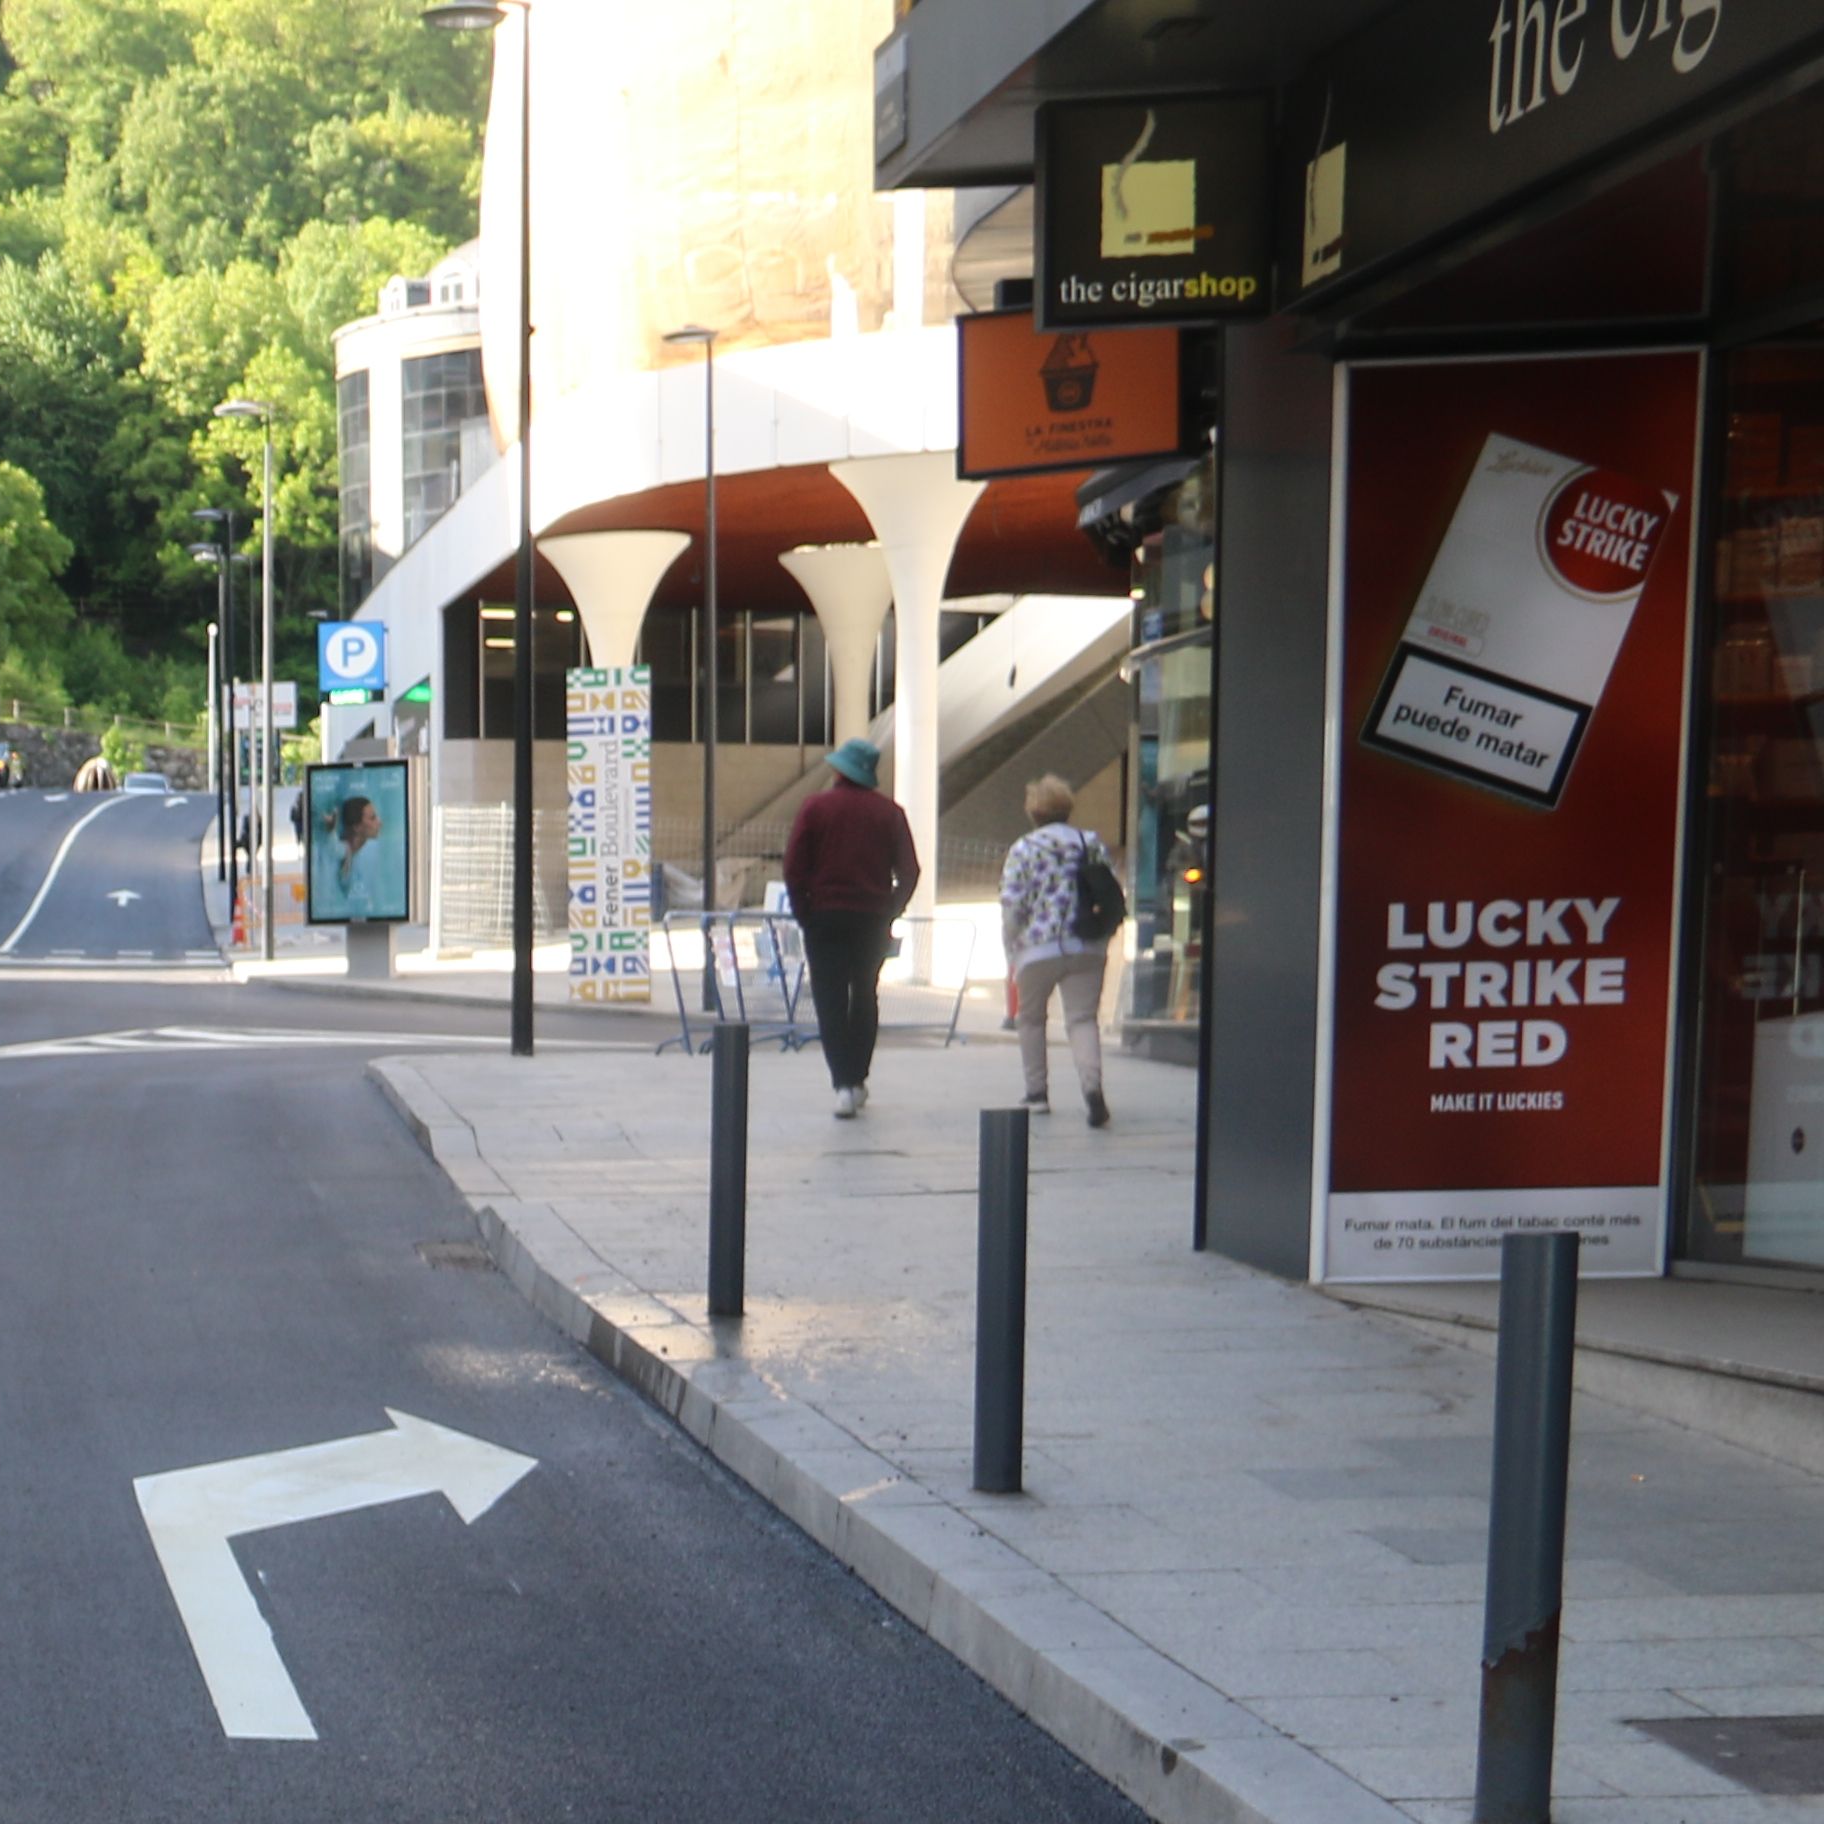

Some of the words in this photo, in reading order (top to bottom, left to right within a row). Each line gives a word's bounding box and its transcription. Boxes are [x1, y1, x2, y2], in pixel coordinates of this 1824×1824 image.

[1610, 0, 1722, 74] cg
[1059, 275, 1103, 304] the
[1112, 271, 1257, 308] cigarshop
[1574, 493, 1658, 540] LUCKY
[1556, 519, 1649, 572] STRIKE
[341, 637, 365, 668] P
[1443, 684, 1524, 730] Fumar
[1391, 702, 1470, 743] puede
[1475, 731, 1550, 770] matar
[600, 739, 619, 858] Boulevard
[602, 865, 619, 927] Fener
[1387, 897, 1621, 949] LUCKY
[1374, 957, 1627, 1011] STRIKE
[1429, 1019, 1568, 1069] RED
[1429, 1093, 1475, 1113] MAKE
[1479, 1093, 1494, 1111] IT
[1497, 1091, 1564, 1111] LUCKIES
[1344, 1218, 1390, 1232] Fumar
[1395, 1217, 1435, 1231] mata.
[1458, 1216, 1487, 1229] fum
[1517, 1215, 1559, 1228] tabac
[1563, 1213, 1604, 1227] conté
[1609, 1213, 1641, 1226] més
[1373, 1237, 1393, 1250] de
[1397, 1236, 1415, 1250] 70
